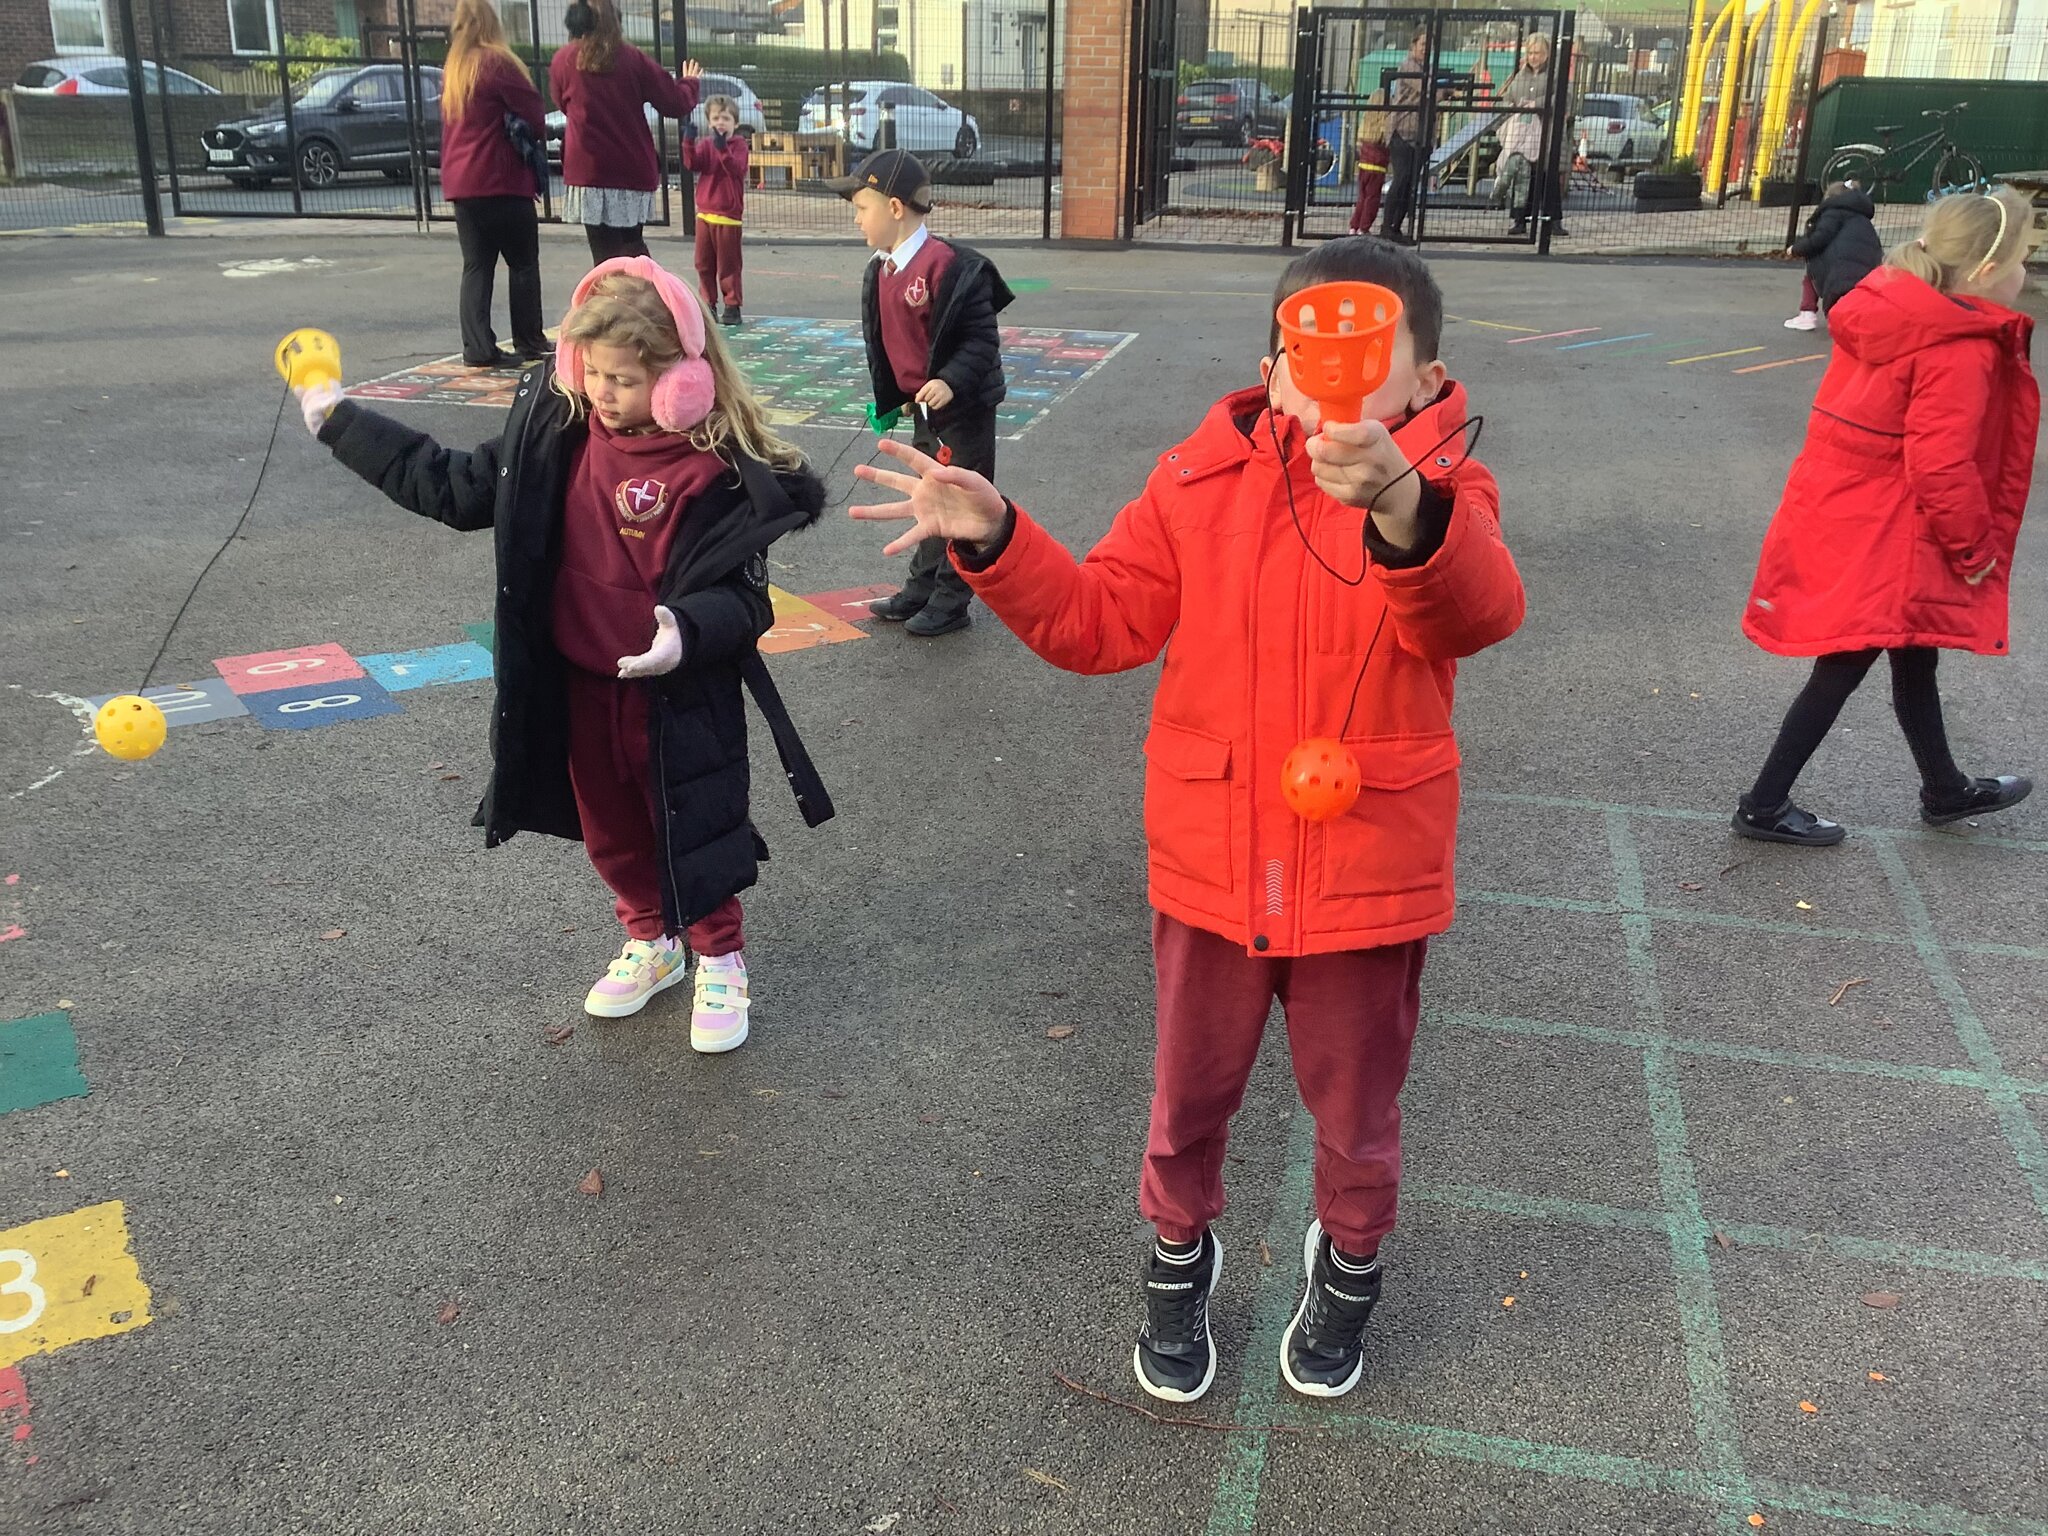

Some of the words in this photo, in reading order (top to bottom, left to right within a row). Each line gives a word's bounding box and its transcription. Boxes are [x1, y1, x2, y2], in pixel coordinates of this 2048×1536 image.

[360, 385, 411, 394] 91
[427, 390, 476, 399] 81
[277, 694, 362, 715] 8
[0, 1249, 46, 1334] 3
[1147, 1281, 1193, 1291] SKECHERS
[1324, 1283, 1371, 1302] SKECHERS
